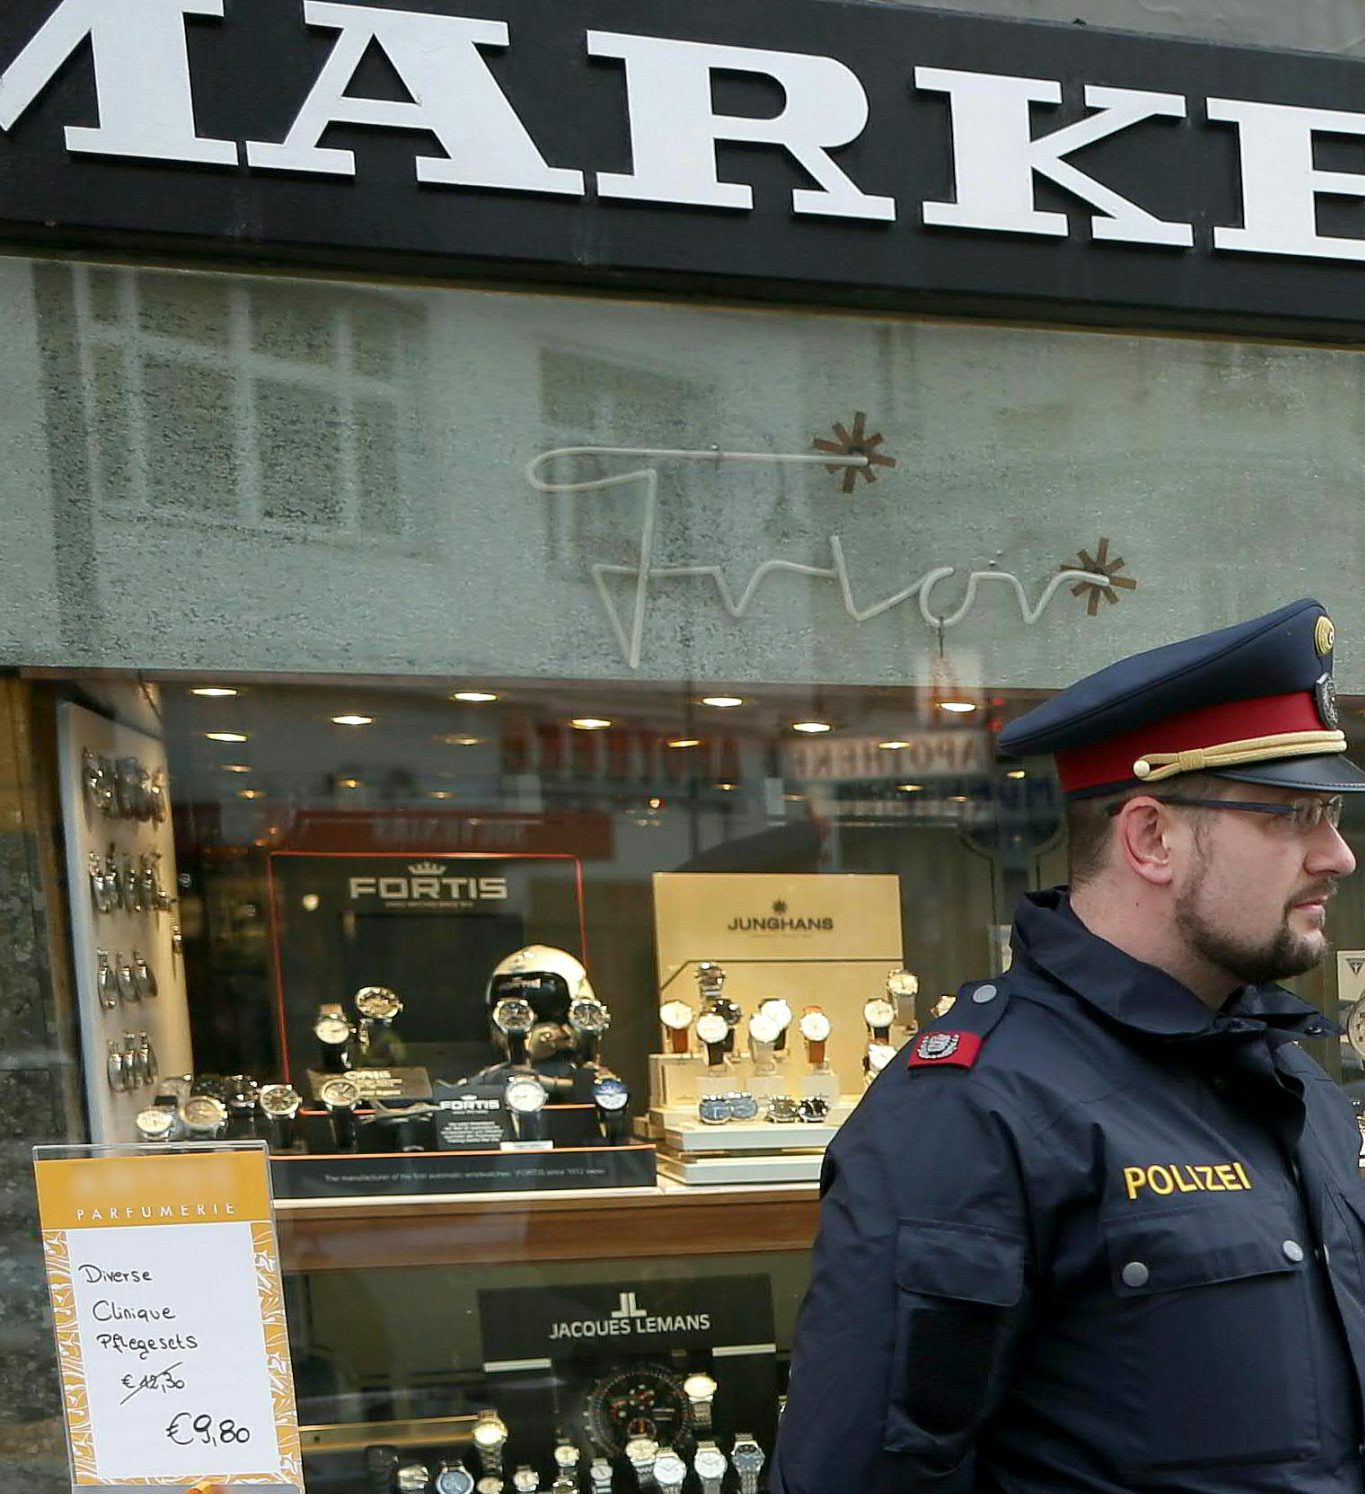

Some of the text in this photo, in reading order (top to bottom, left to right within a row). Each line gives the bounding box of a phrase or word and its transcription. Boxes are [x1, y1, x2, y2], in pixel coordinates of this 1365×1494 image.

[350, 876, 508, 900] FORTIS
[727, 917, 834, 931] JUNGHANS
[440, 1099, 500, 1112] FORTIS
[1123, 1161, 1253, 1200] POLIZEI
[76, 1202, 236, 1221] PARFUMERIE
[78, 1264, 154, 1284] Diverse
[92, 1300, 177, 1323] Clinique
[549, 1313, 711, 1340] JACQUES LEMANS
